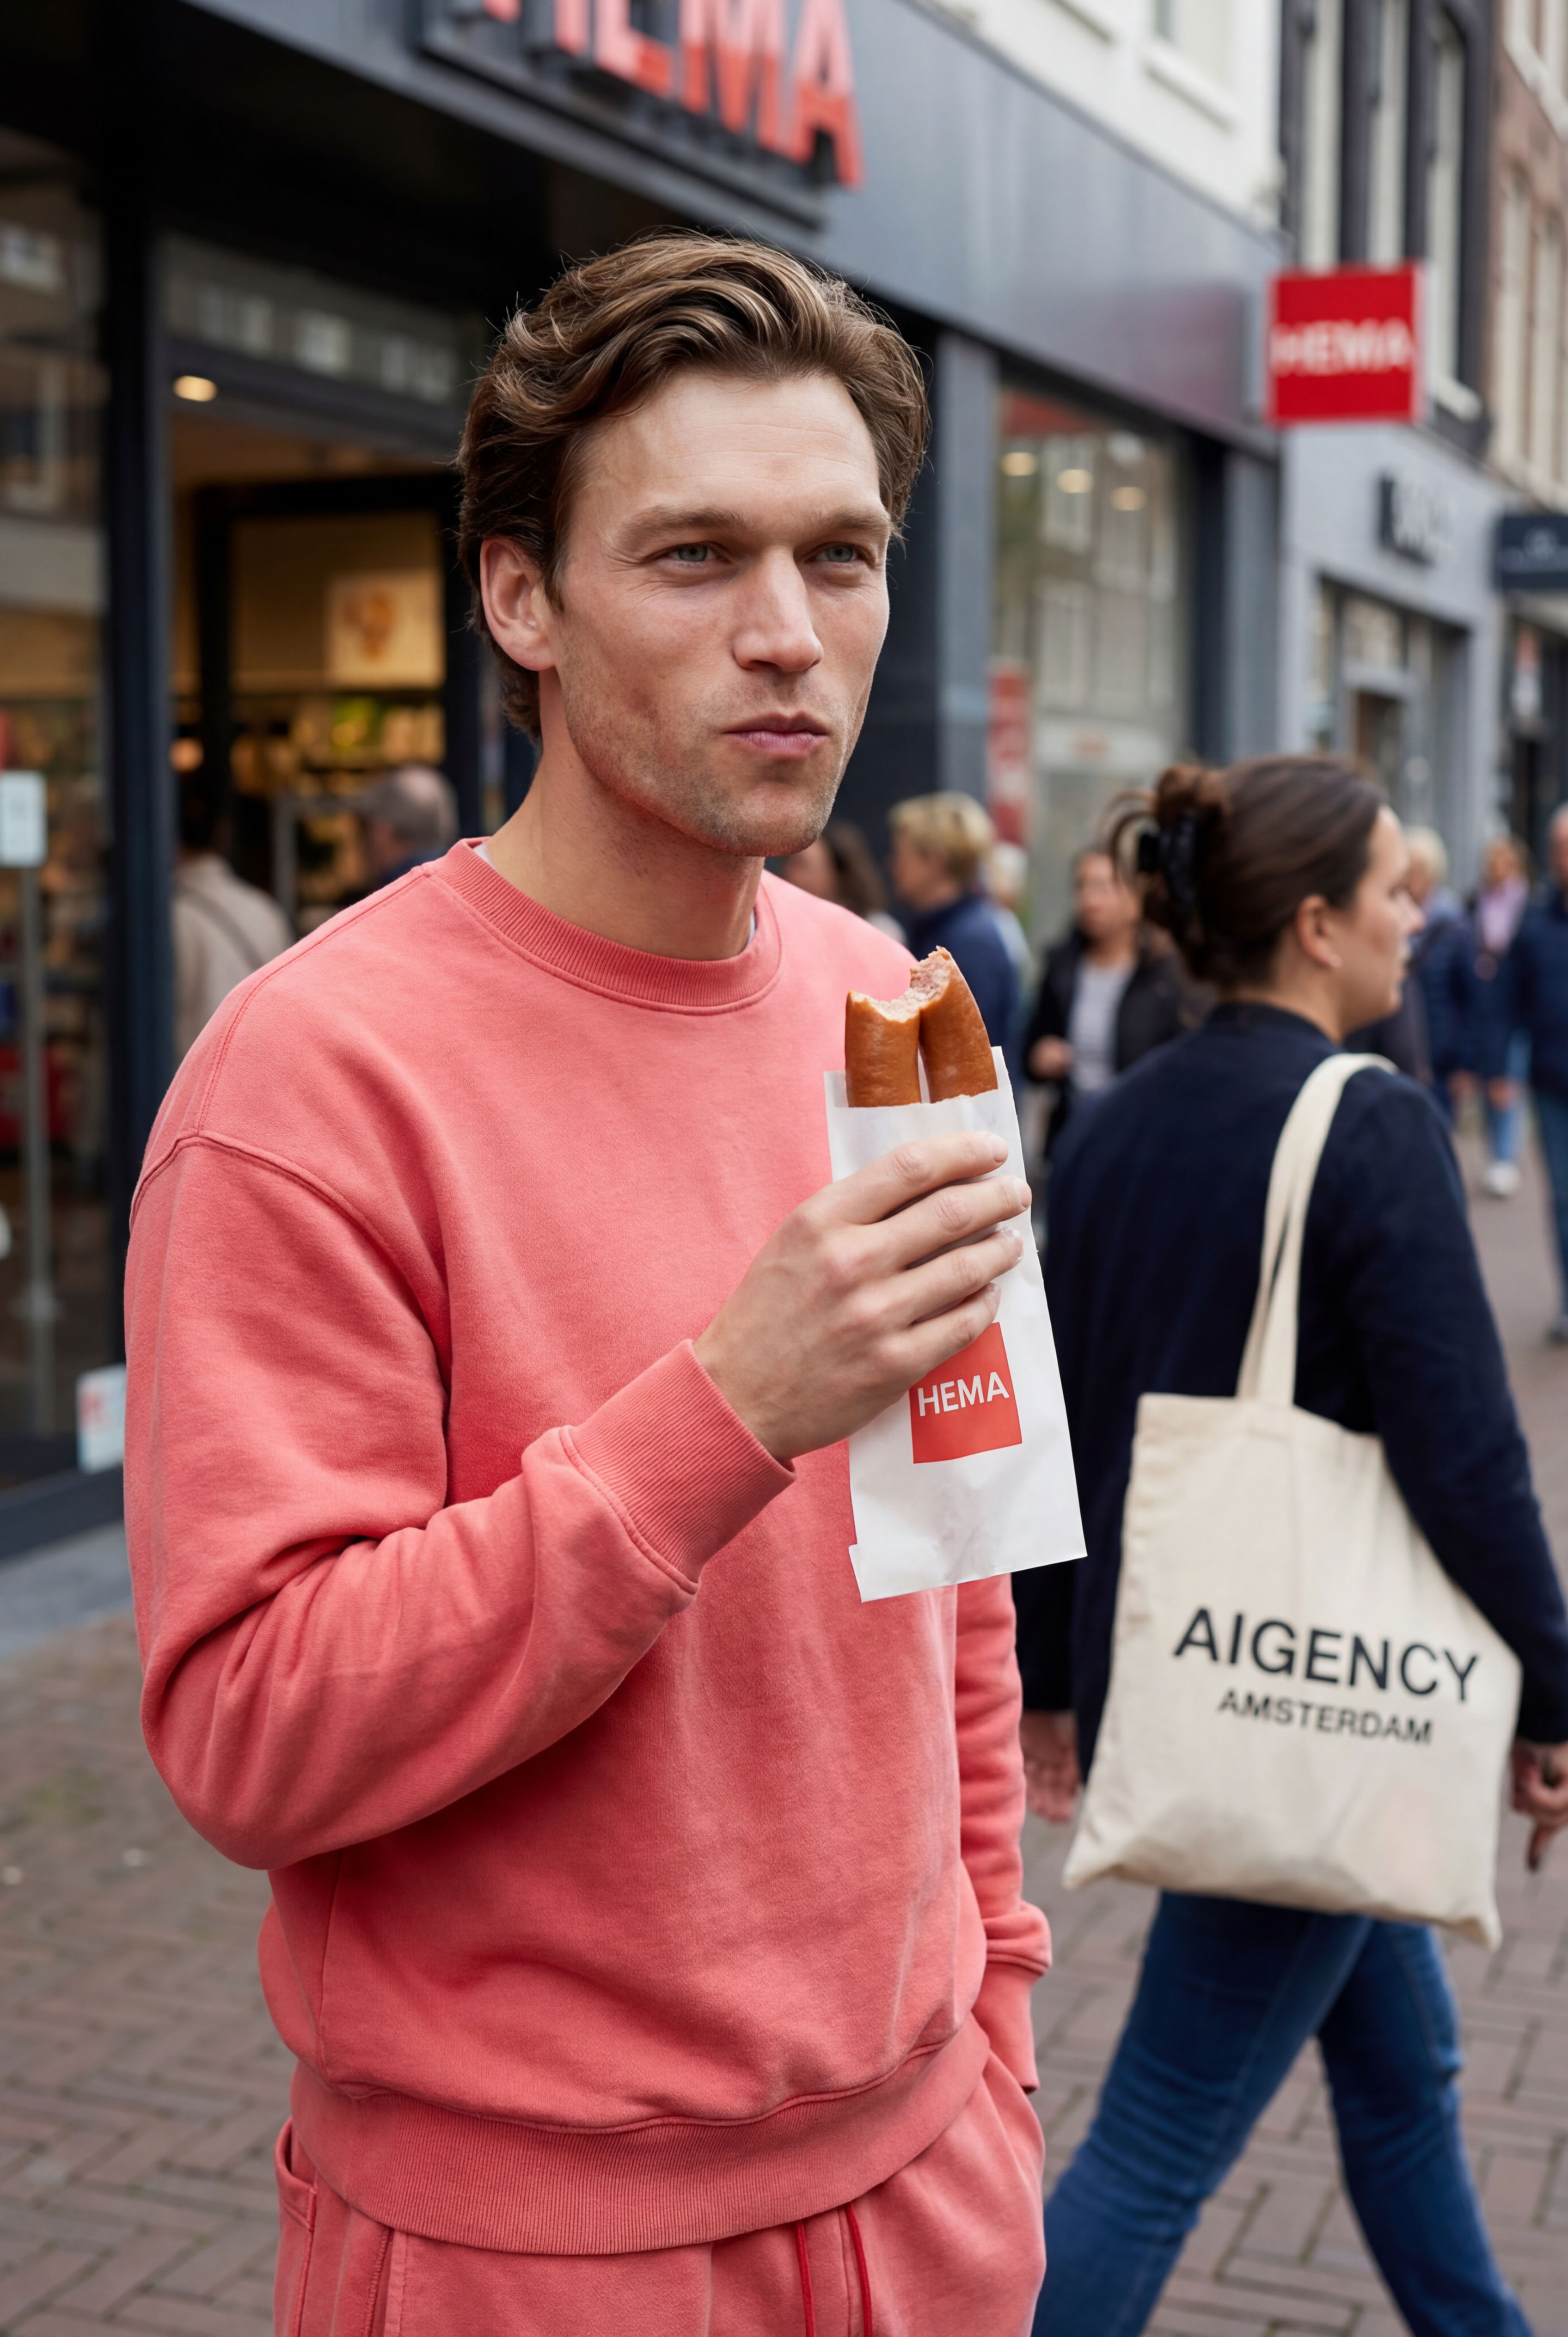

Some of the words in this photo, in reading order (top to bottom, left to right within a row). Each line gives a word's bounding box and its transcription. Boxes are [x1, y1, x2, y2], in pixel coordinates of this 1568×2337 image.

[1271, 319, 1413, 375] HEMA
[918, 1371, 1010, 1417] HEMA
[1173, 1606, 1480, 1702] AIGENCY
[1218, 1687, 1433, 1745] AMSTERDAM
